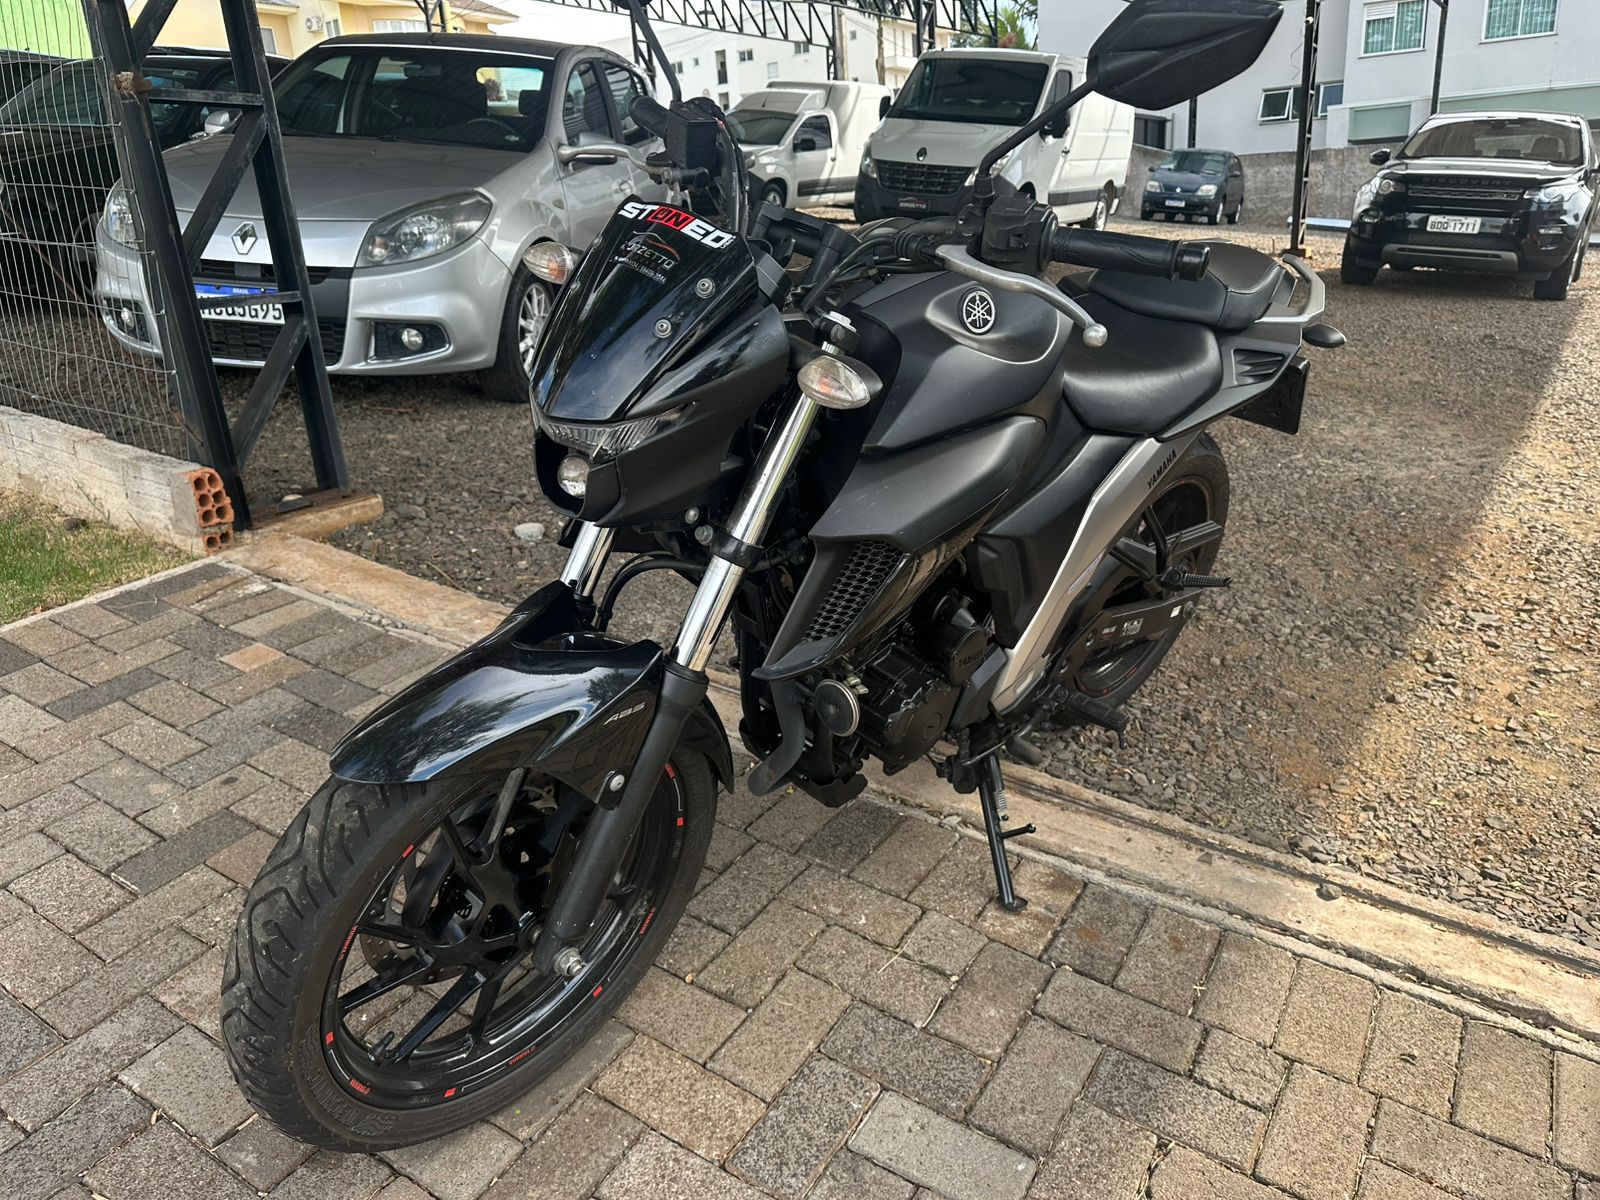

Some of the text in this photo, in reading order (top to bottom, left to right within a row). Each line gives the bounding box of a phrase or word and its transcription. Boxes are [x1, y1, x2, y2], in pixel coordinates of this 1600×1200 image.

[618, 201, 733, 249] STONED
[1147, 449, 1177, 490] YAMAHA
[602, 701, 646, 726] ABS
